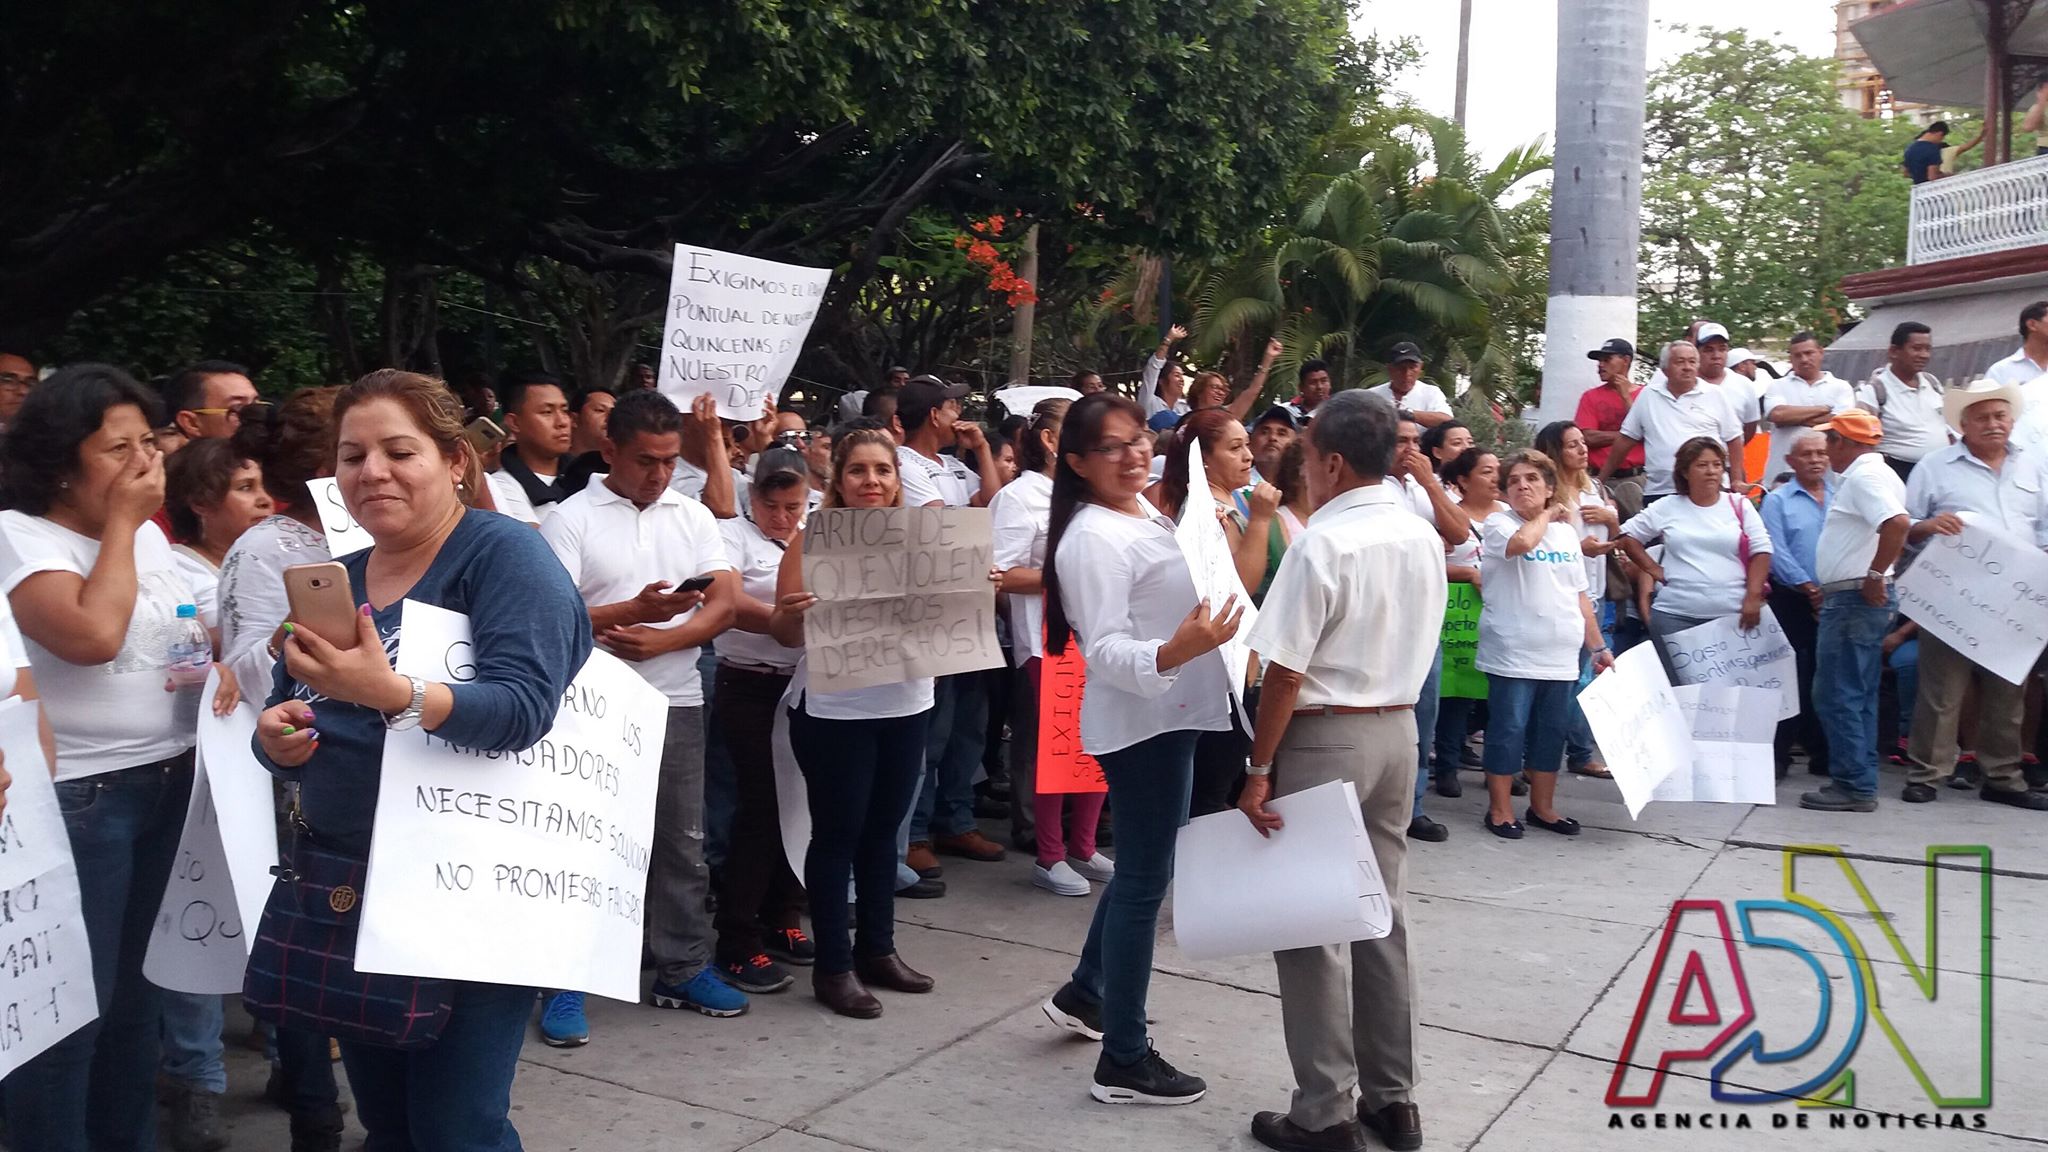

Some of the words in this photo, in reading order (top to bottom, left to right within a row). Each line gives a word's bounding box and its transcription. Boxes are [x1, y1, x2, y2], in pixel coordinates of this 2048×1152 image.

[688, 252, 787, 294] EXIGIMOS
[672, 294, 754, 324] PUNTUAL
[762, 310, 778, 325] DE
[670, 328, 772, 354] QUINCENAS
[669, 355, 769, 383] NUESTRO
[808, 508, 906, 554] ARTOS
[919, 508, 956, 547] DE
[808, 593, 944, 645] NUESTROS
[1446, 586, 1472, 610] olo
[621, 714, 642, 757] LOS
[416, 784, 603, 844] NECESITAMOS
[435, 862, 474, 891] NO
[493, 863, 603, 908] PROMESAS
